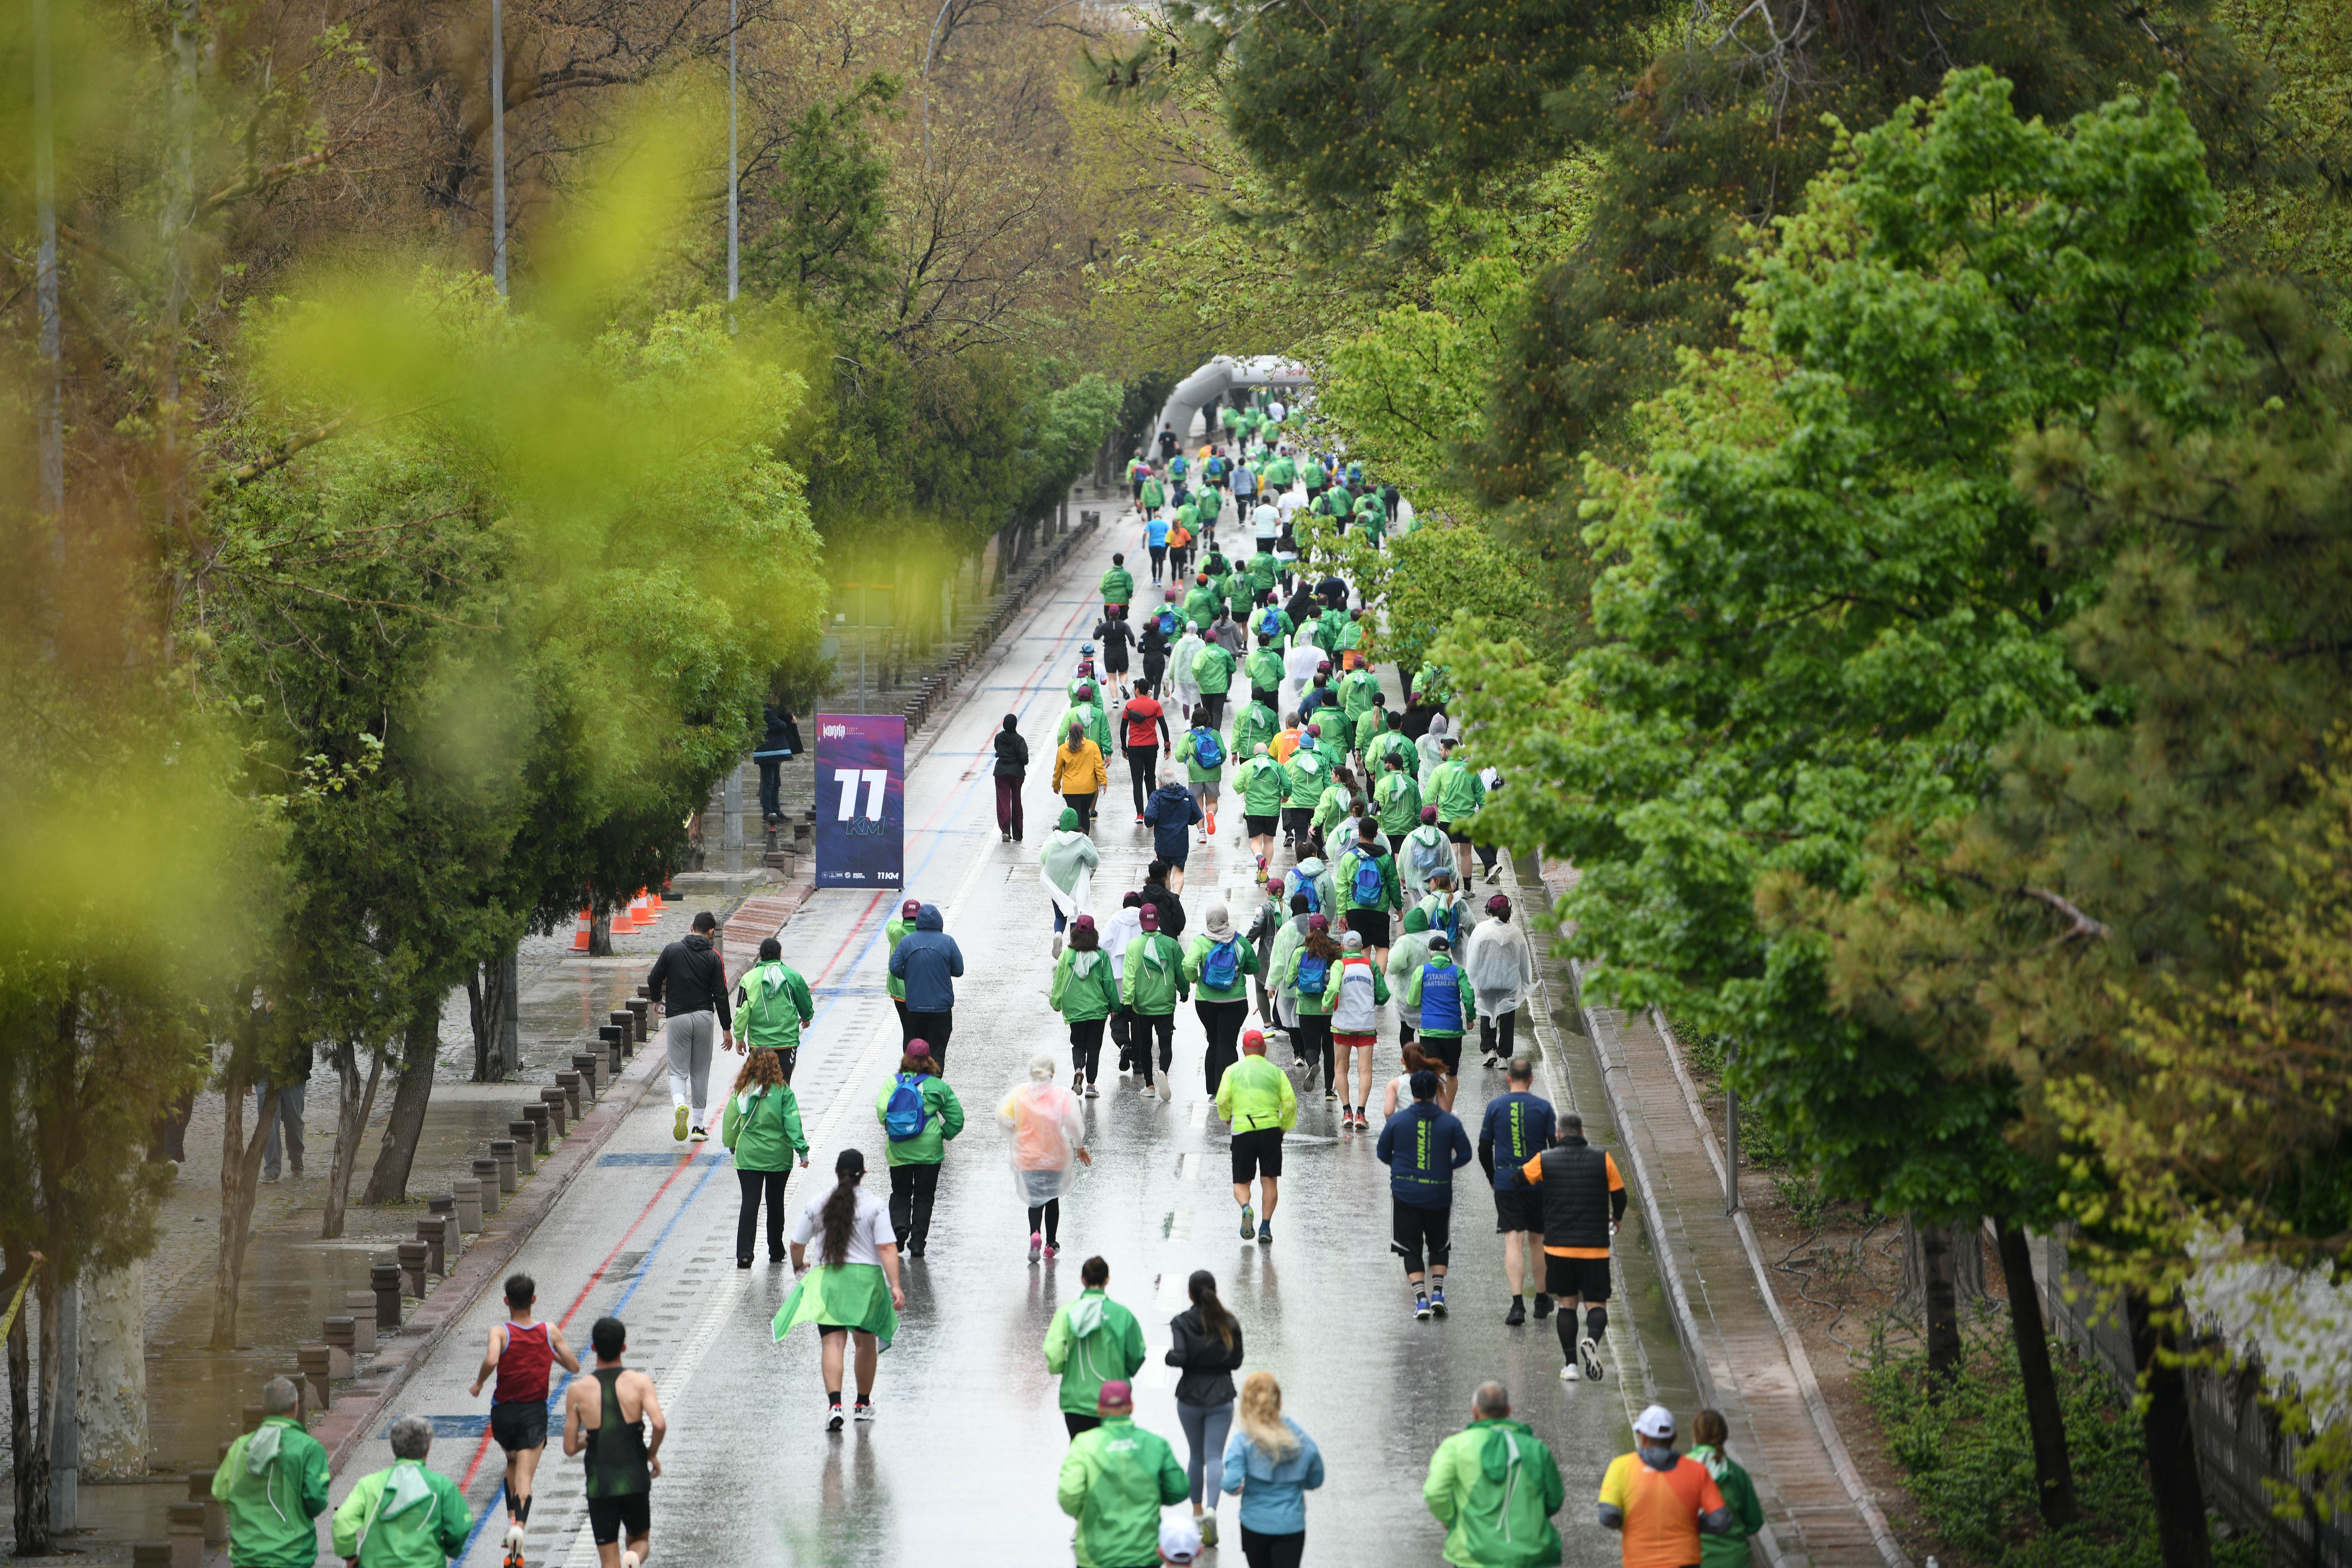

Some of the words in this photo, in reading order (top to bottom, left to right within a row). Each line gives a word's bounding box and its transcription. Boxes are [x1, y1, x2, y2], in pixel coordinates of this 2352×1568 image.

[834, 769, 888, 822] 11
[846, 816, 885, 835] KM
[1417, 1119, 1426, 1170] RUNKAR
[1510, 1102, 1522, 1157] RUNKARA
